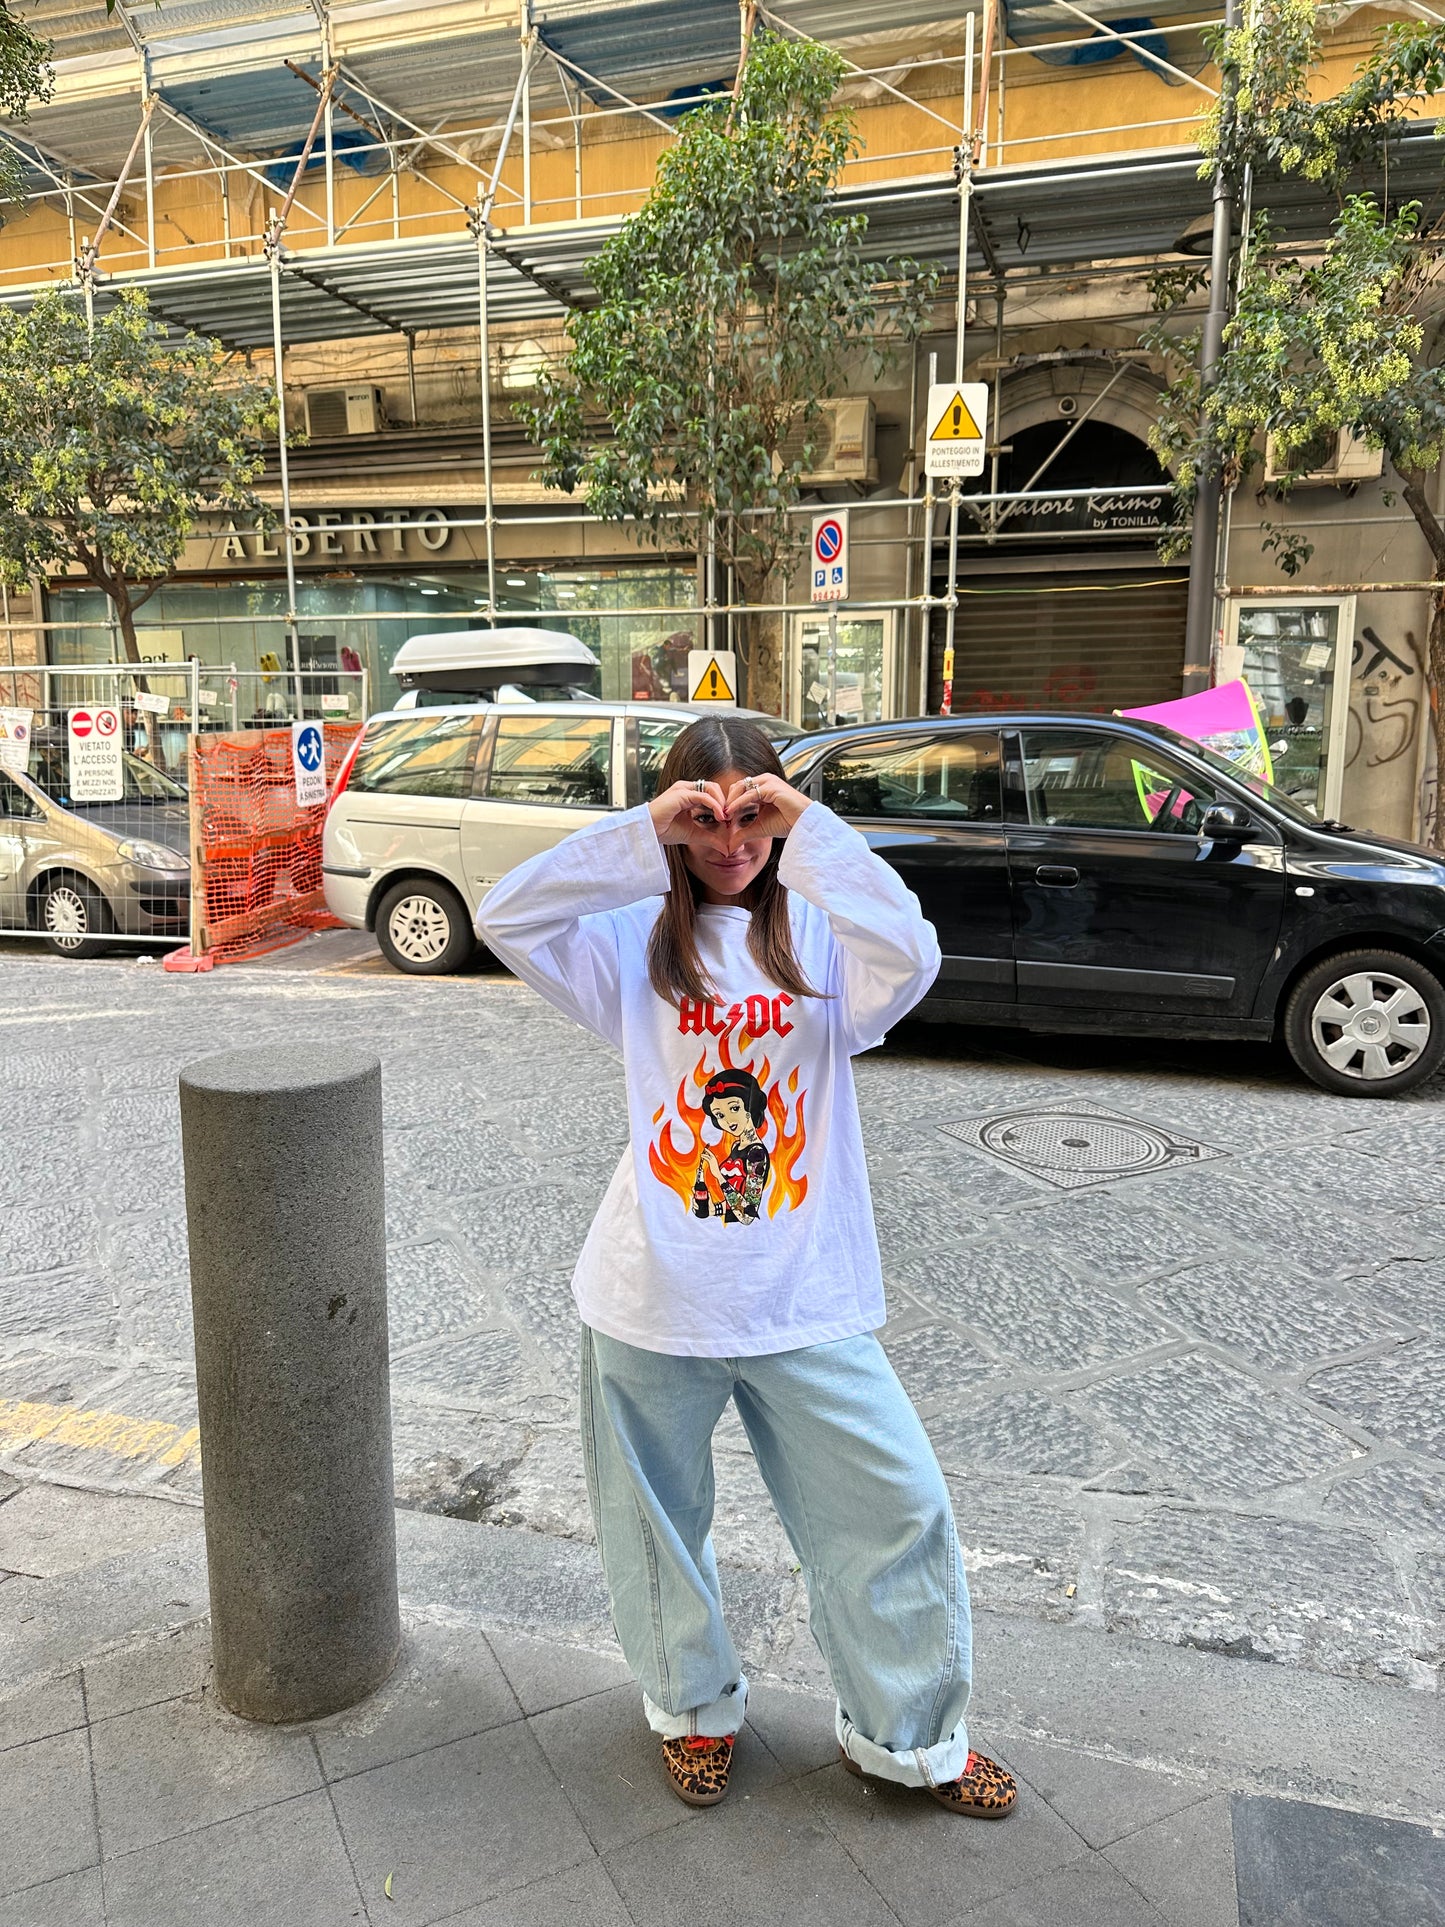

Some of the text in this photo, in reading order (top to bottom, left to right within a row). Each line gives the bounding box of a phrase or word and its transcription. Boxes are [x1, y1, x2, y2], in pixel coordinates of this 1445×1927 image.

[931, 446, 980, 456] PONTEGGIO IN
[930, 458, 980, 468] ALLESTIMENTO
[1087, 493, 1162, 514] Kaimo
[1093, 515, 1160, 529] by TONILIA
[221, 508, 449, 558] ALBERTO
[817, 571, 825, 586] P
[79, 741, 111, 751] VIETATO
[73, 754, 117, 765] L'ACCESSO
[78, 769, 114, 777] A PERSONE
[81, 779, 101, 787] MEZZI
[303, 776, 322, 787] PEDONI
[304, 789, 326, 801] SINISTRA
